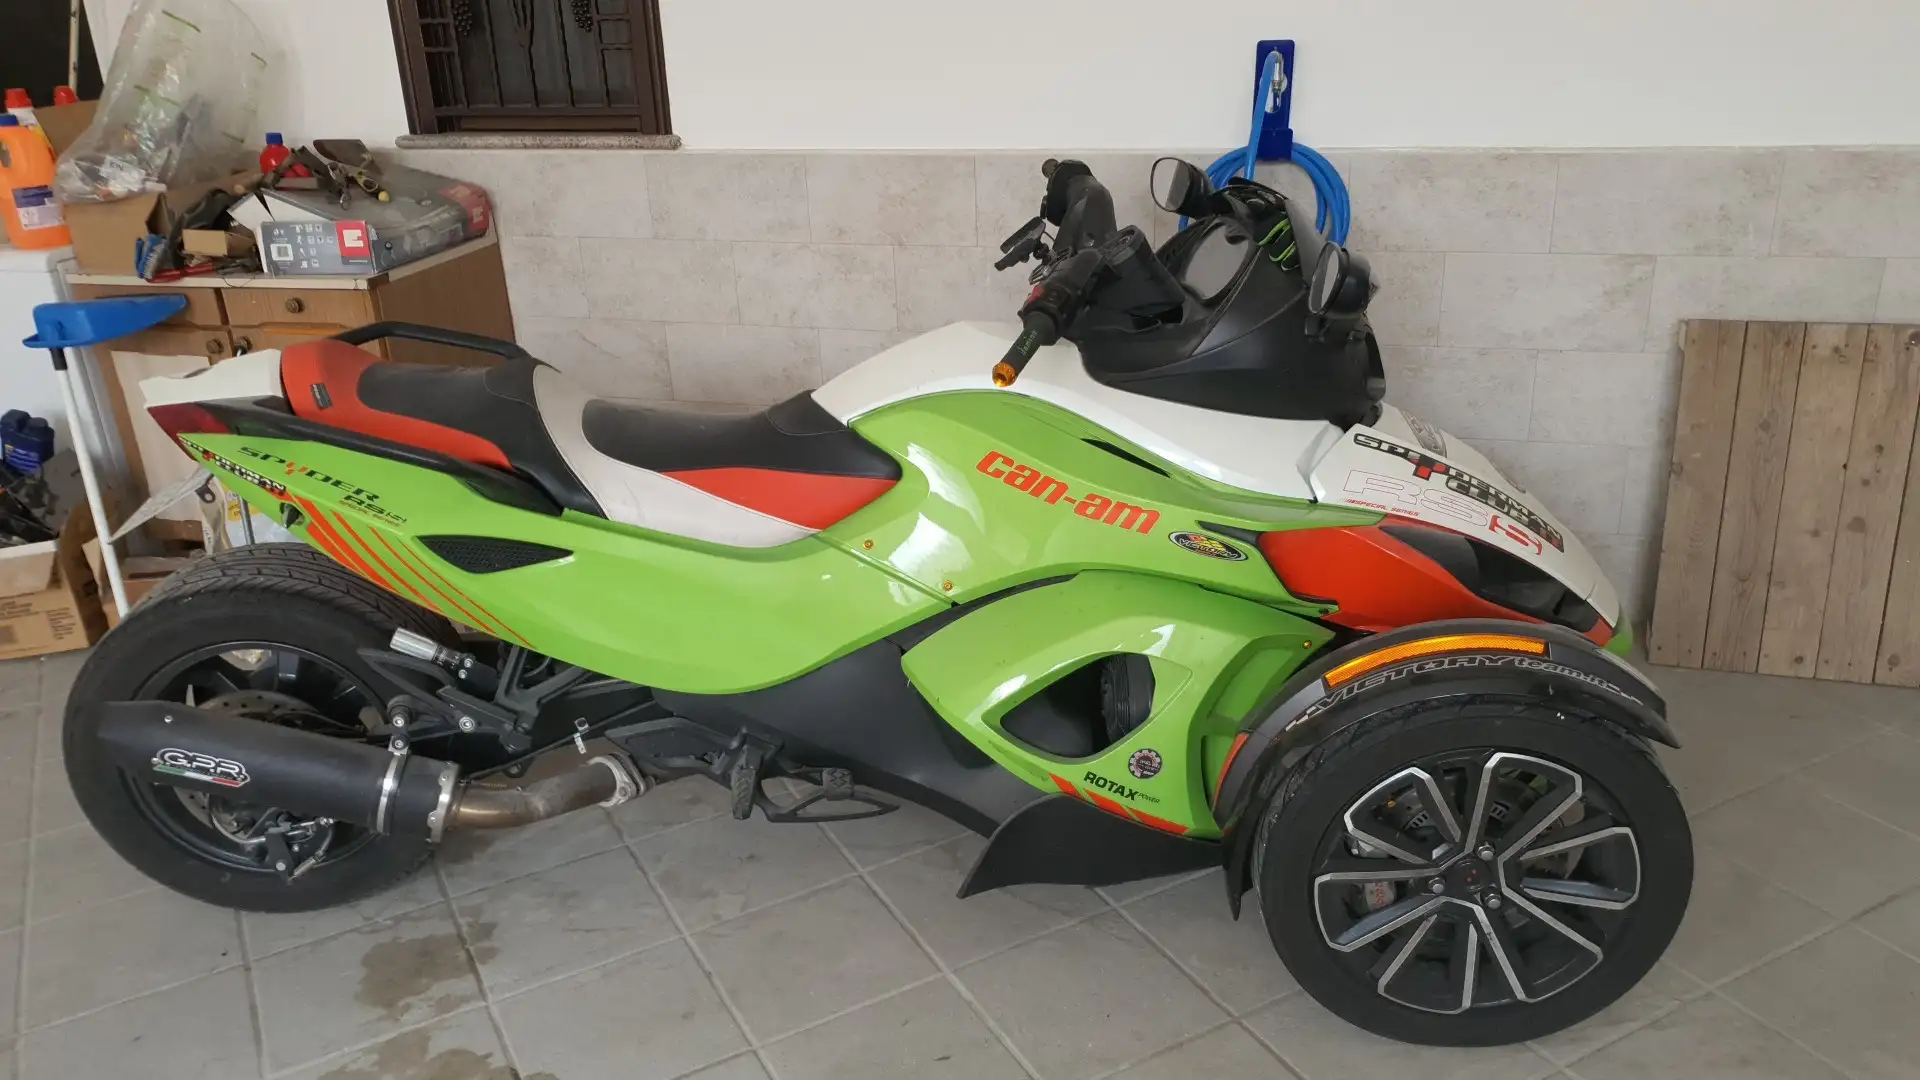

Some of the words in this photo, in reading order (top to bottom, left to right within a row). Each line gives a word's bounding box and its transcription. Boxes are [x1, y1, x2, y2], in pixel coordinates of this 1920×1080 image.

[237, 447, 380, 502] SPYDER
[976, 450, 1160, 536] can-am
[1316, 655, 1514, 711] VICTORY
[1083, 770, 1139, 801] ROTAX
